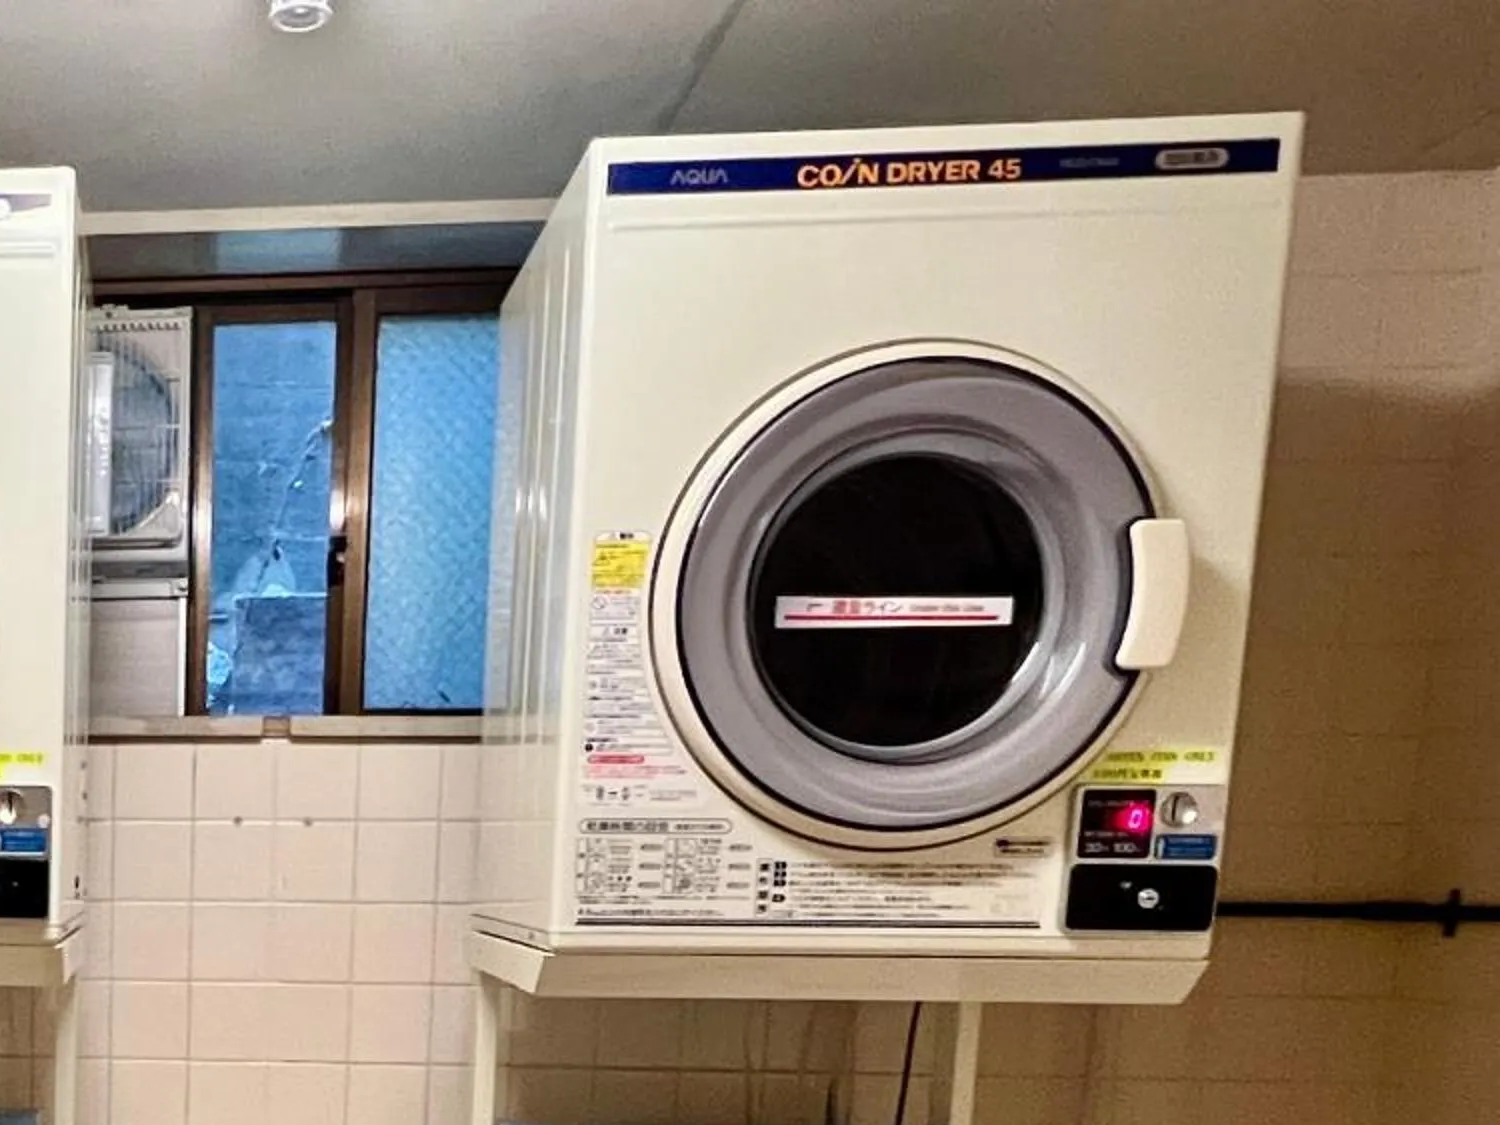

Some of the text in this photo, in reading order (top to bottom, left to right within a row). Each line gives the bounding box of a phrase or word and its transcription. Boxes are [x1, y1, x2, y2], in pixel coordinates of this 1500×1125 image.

[670, 168, 728, 185] AQUA
[887, 160, 981, 184] DRYER
[988, 157, 1022, 179] 45
[1128, 808, 1143, 829] 0
